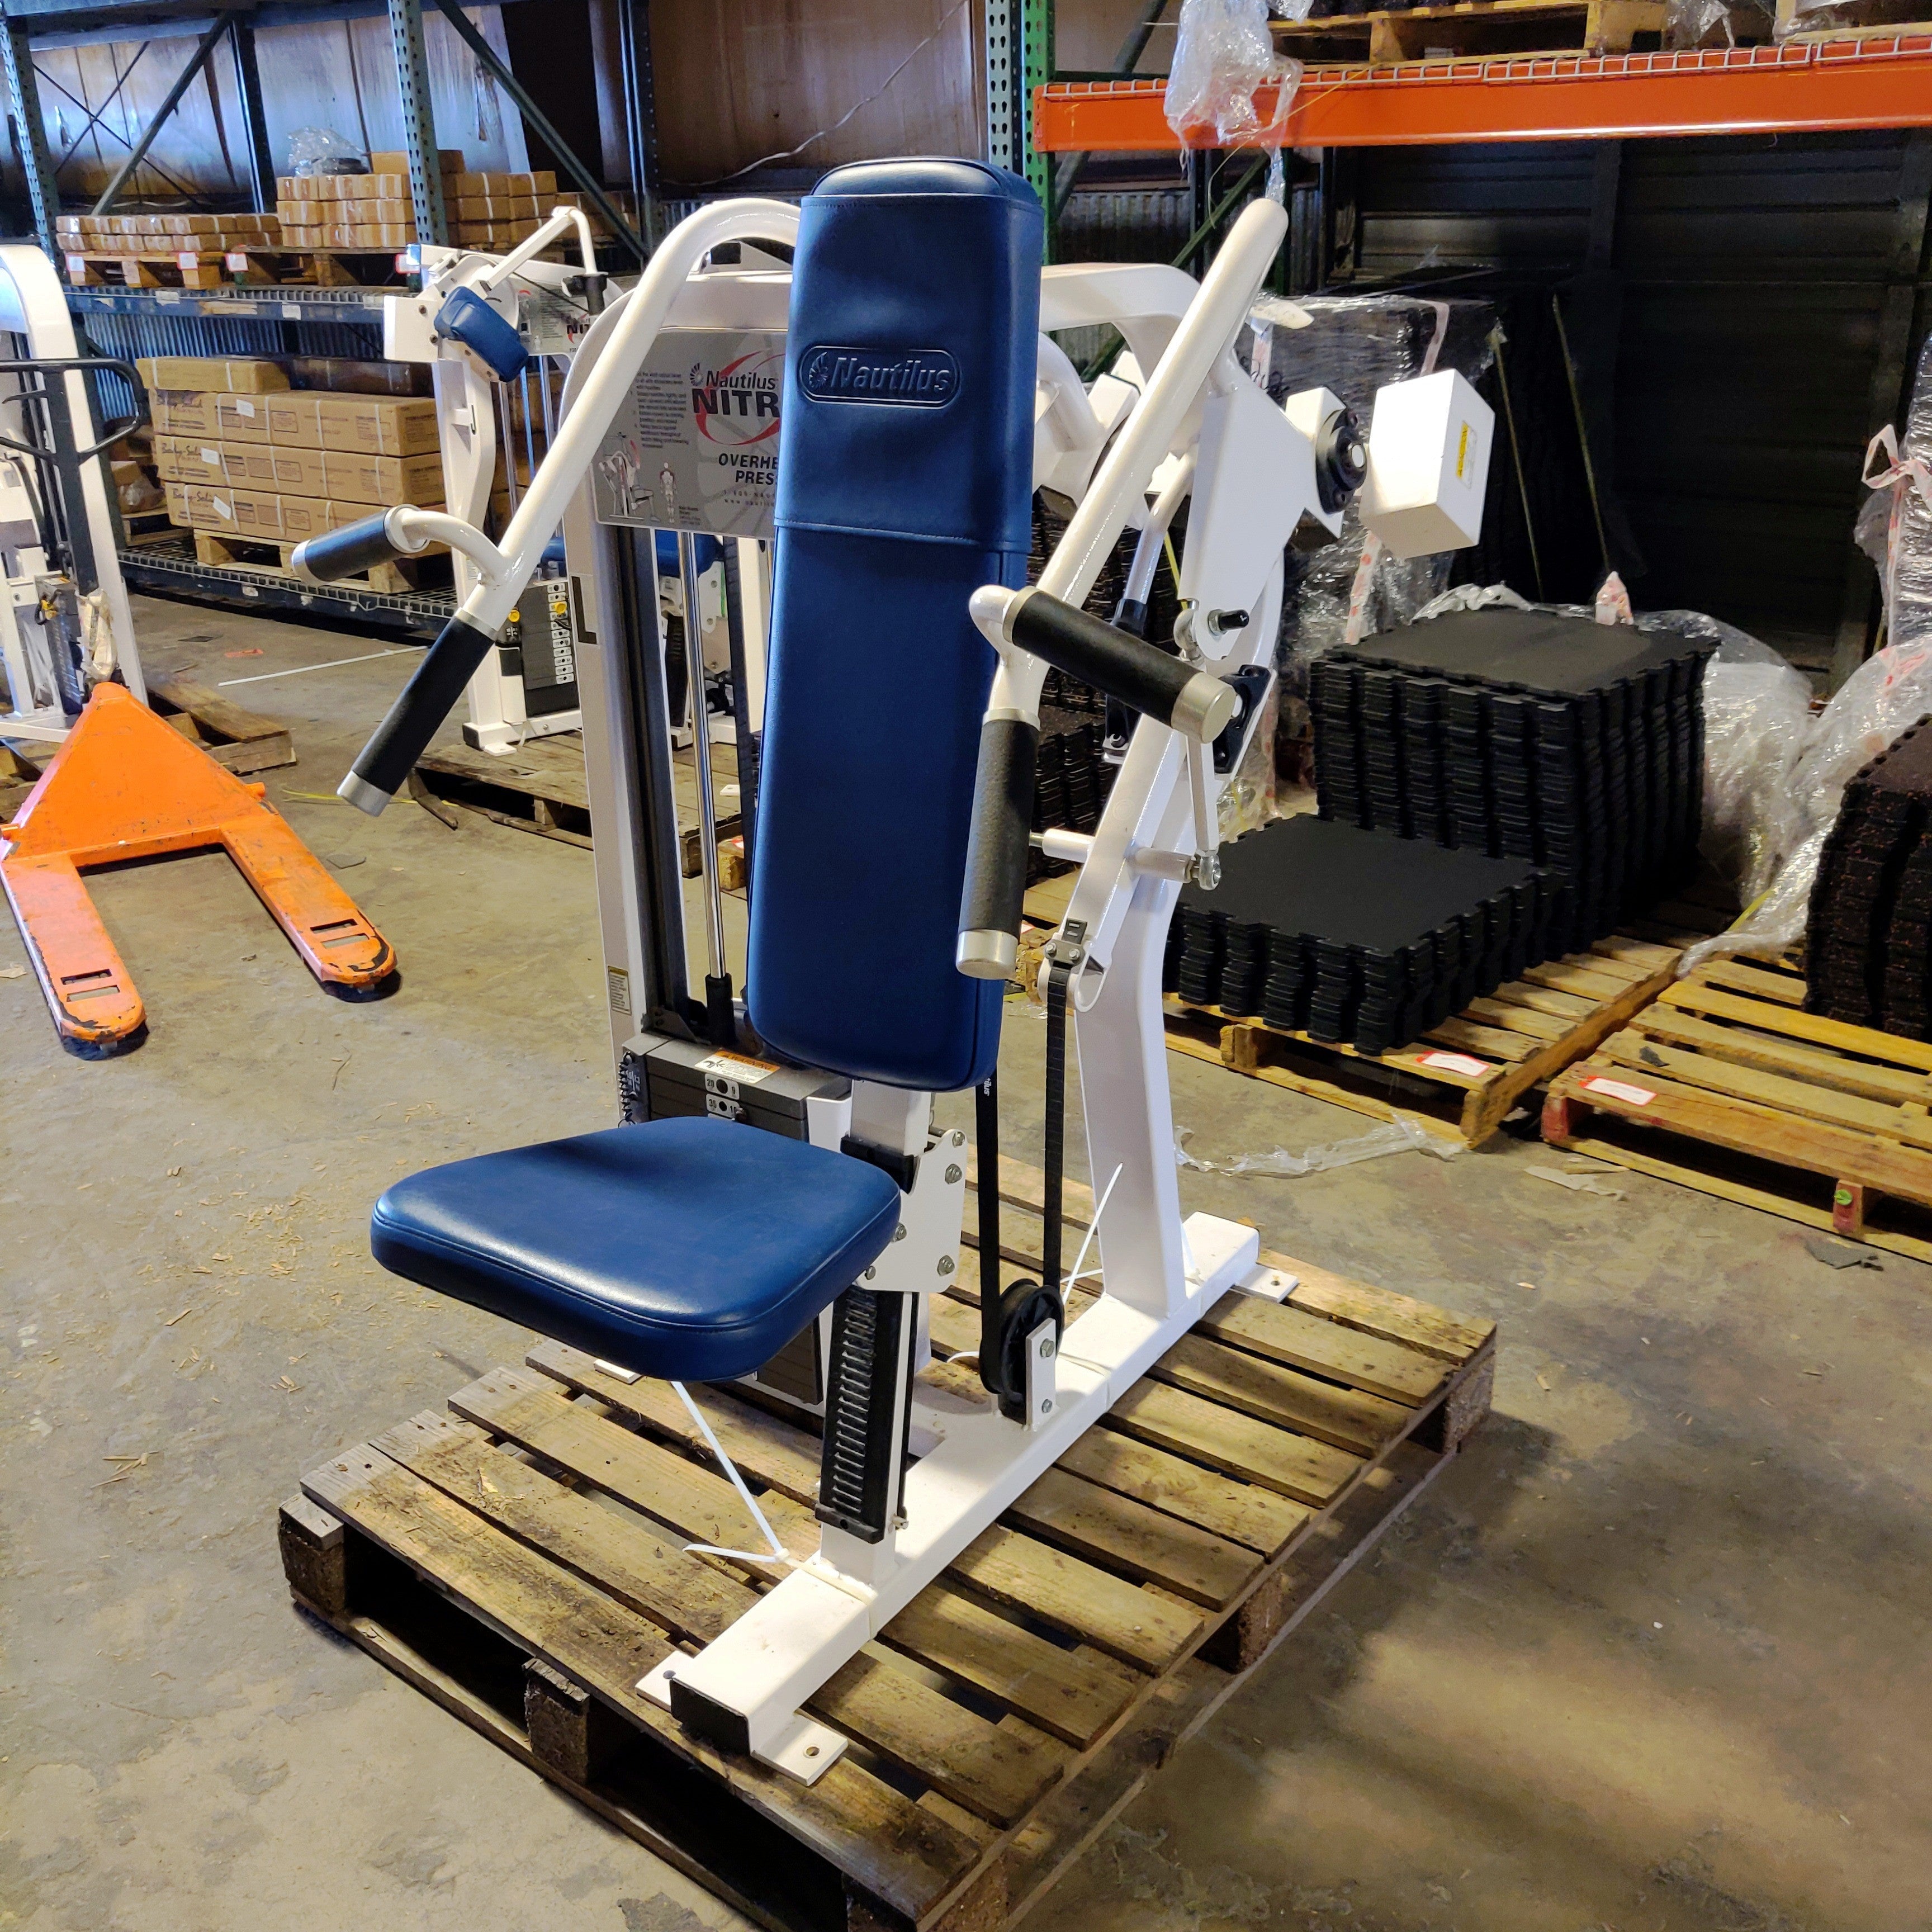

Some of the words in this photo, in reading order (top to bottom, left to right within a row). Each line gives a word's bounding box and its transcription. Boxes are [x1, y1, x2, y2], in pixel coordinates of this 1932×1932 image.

[706, 370, 776, 390] Nautilus
[830, 357, 950, 391] Nautilus
[692, 388, 781, 418] NITR
[735, 470, 778, 486] PRES
[707, 1079, 715, 1090] 20
[709, 1098, 717, 1109] 35
